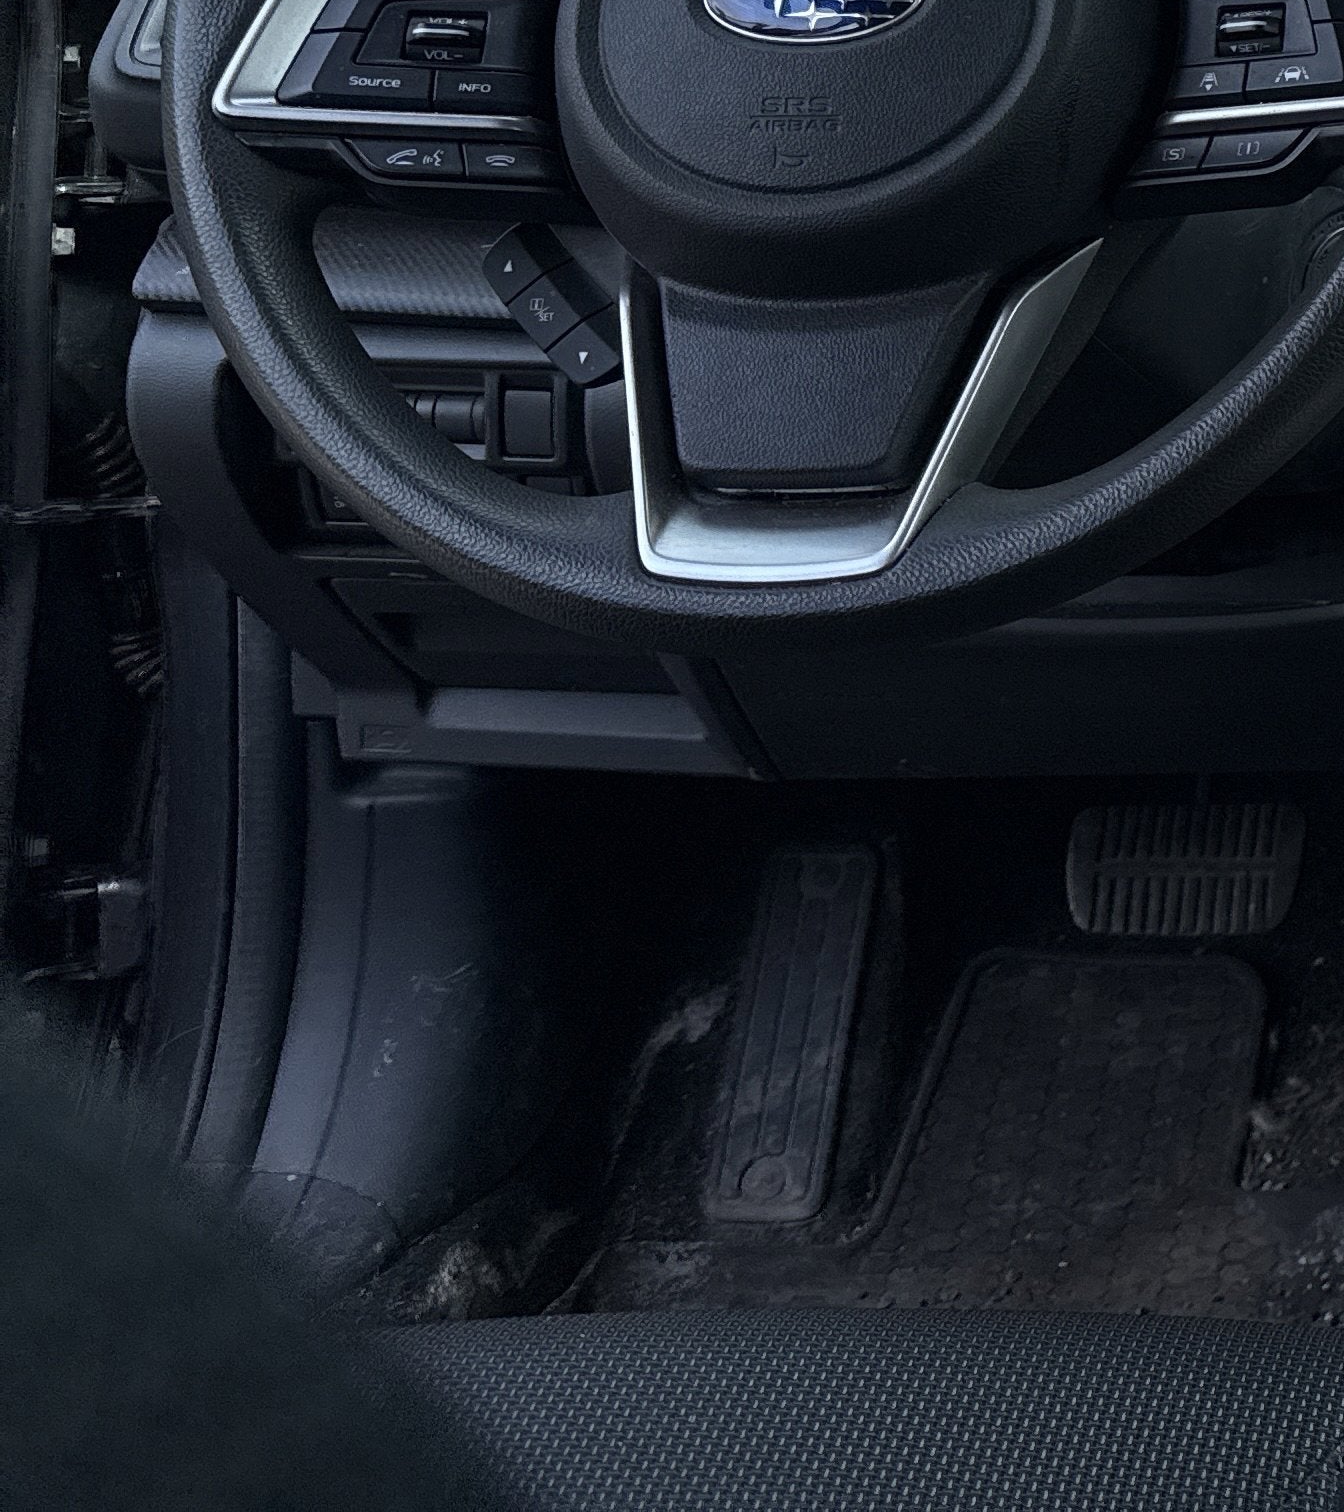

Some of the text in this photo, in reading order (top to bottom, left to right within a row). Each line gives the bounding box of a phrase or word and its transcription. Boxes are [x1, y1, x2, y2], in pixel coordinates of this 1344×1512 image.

[349, 76, 402, 88] Source
[458, 83, 492, 93] INFO
[761, 96, 833, 114] SRS
[749, 119, 840, 133] AIRBAG
